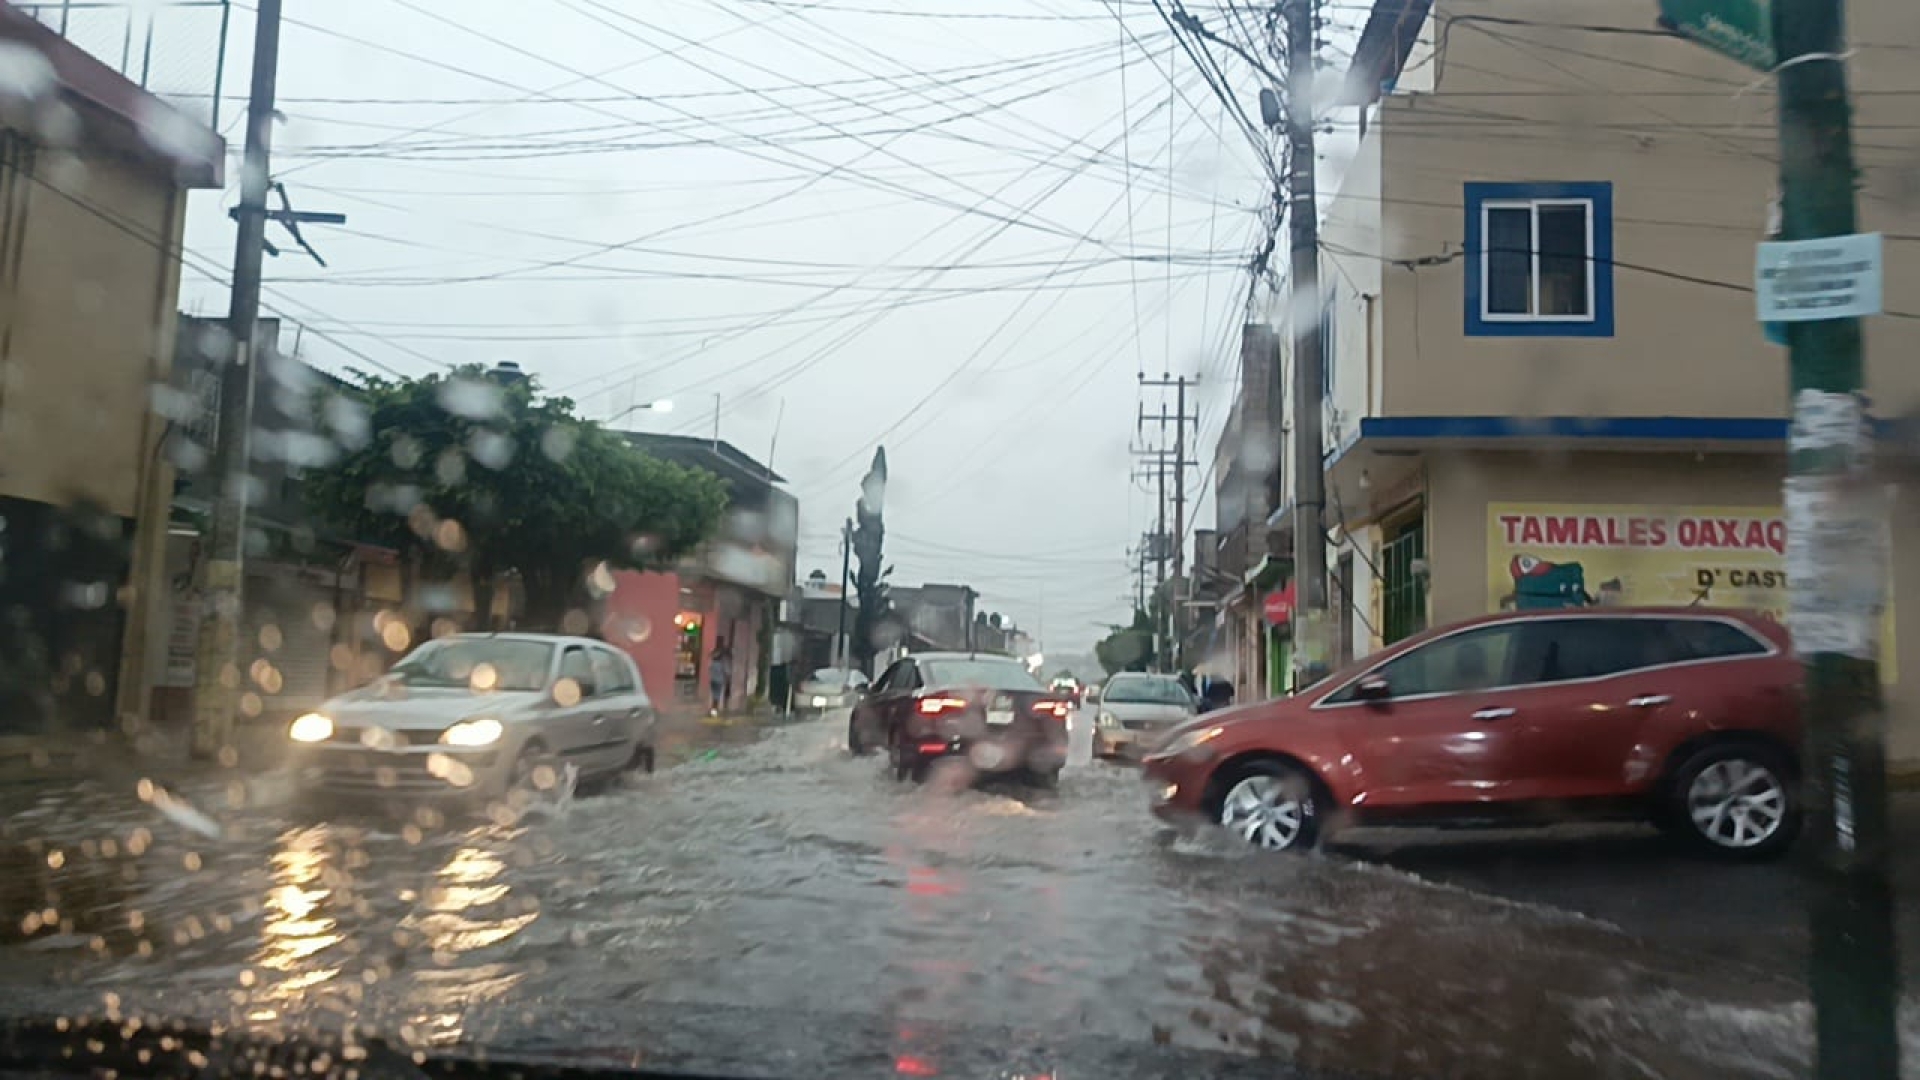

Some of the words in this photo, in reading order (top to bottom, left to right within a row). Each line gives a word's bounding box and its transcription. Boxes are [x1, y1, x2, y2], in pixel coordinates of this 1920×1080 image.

[1500, 515, 1667, 546] TAMALES
[1677, 518, 1786, 555] OAXAQ
[1697, 568, 1721, 588] D'
[1729, 569, 1787, 589] CAST
